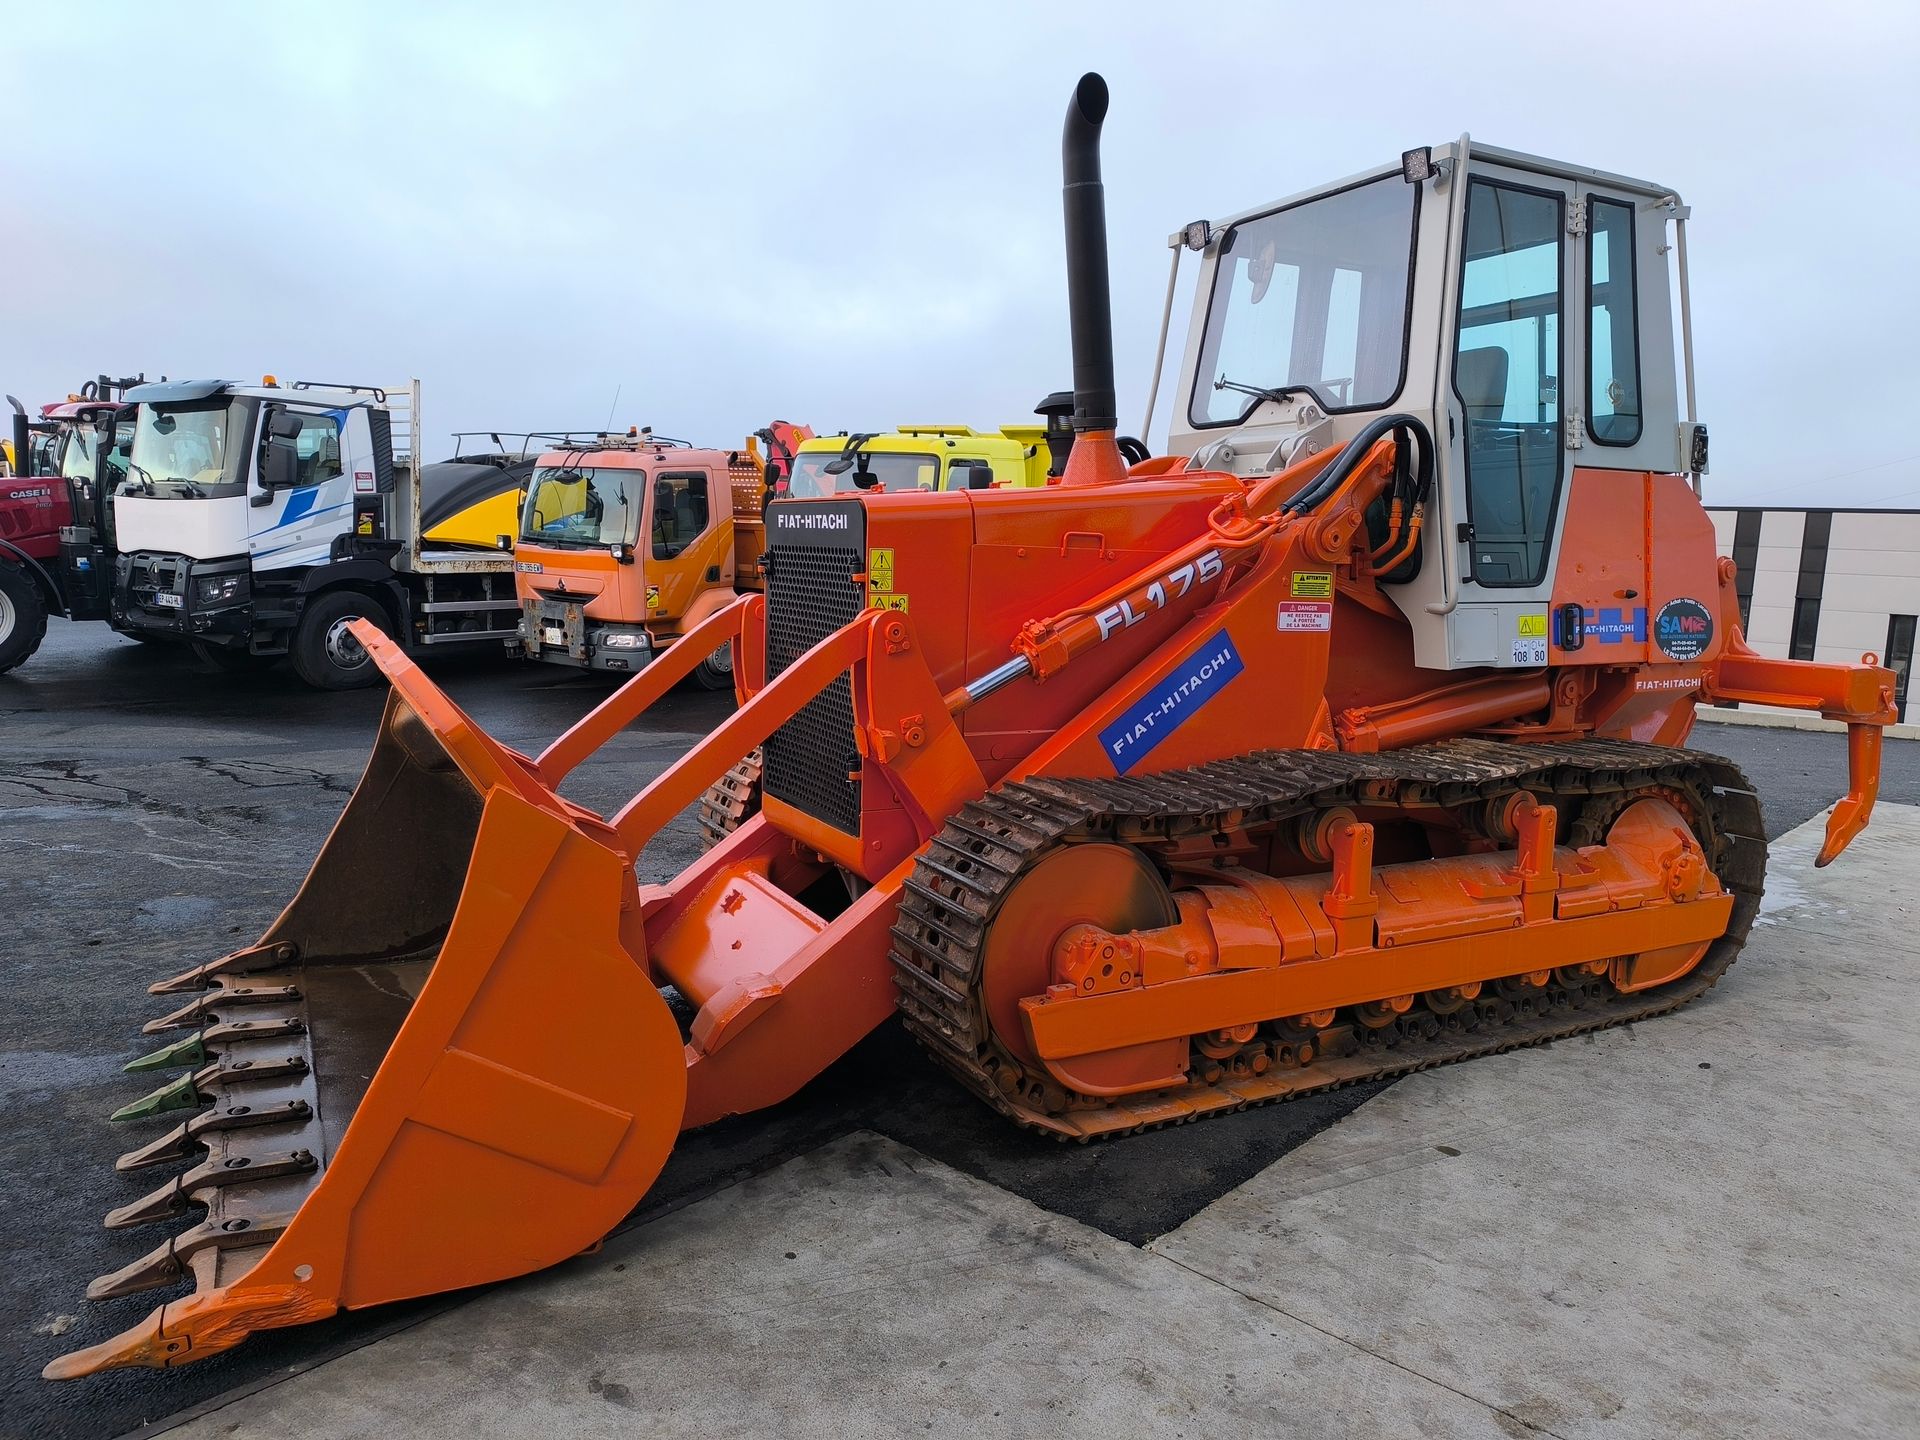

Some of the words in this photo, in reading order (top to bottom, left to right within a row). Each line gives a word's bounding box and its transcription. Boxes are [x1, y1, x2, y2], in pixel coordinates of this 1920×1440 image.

[10, 490, 40, 499] CASE
[777, 513, 848, 530] FIAT-HITACHI
[1575, 624, 1634, 634] FAT-HITACHI
[1512, 651, 1528, 662] 108
[1534, 650, 1545, 661] 80
[1663, 646, 1670, 656] LE
[1669, 651, 1680, 660] PUY
[1686, 647, 1702, 660] VELAY
[1636, 678, 1701, 690] FIAT-HITACHI
[1112, 648, 1231, 755] FIAT-HITACHI
